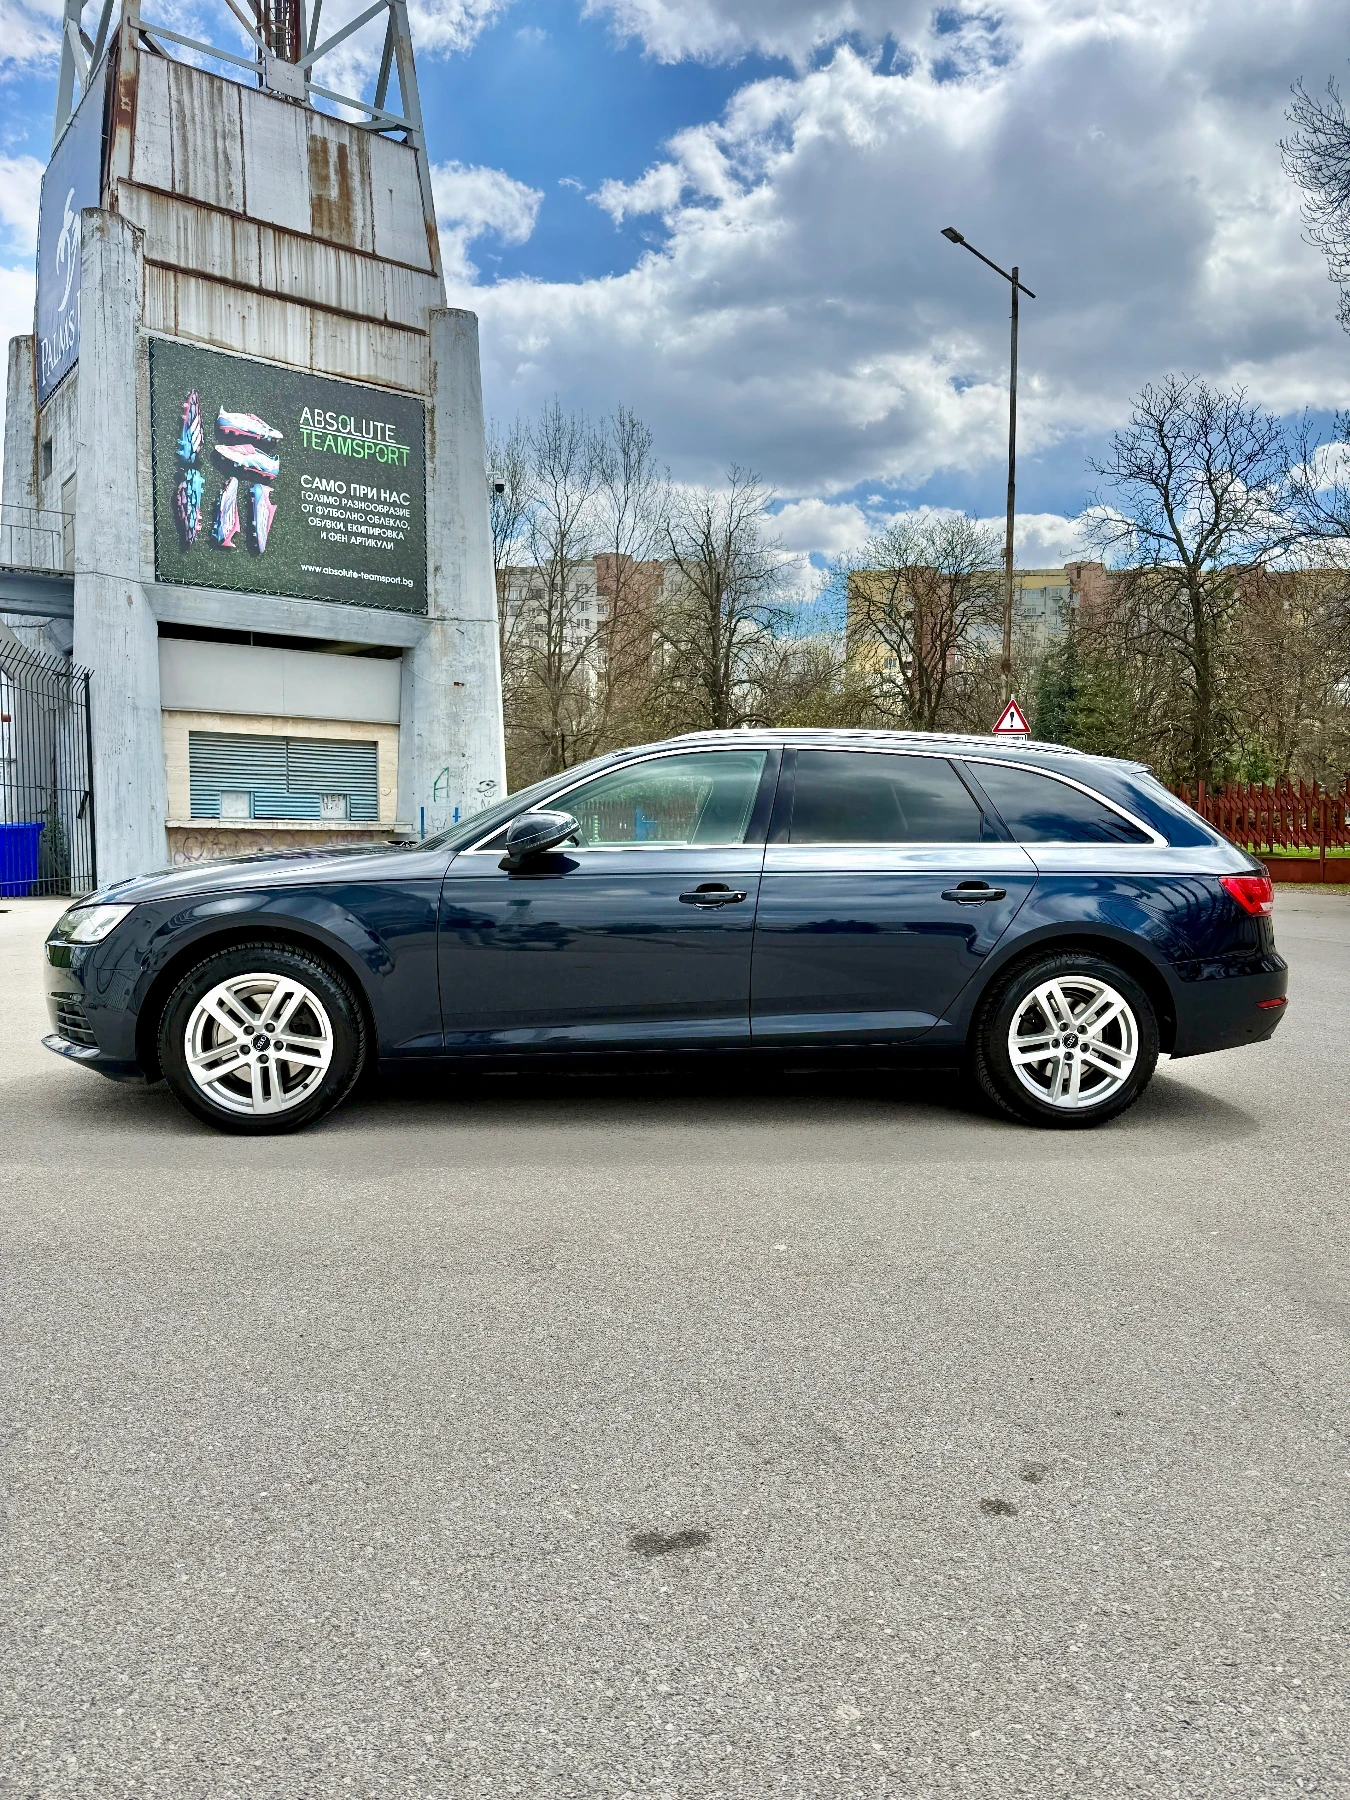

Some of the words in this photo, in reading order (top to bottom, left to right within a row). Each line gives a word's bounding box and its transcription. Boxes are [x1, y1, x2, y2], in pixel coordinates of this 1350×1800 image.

[41, 309, 75, 387] PALMS
[300, 406, 396, 443] ABSOLUTE
[300, 428, 410, 467] TEAMSPORT
[300, 474, 347, 495] САМО
[351, 483, 377, 500] ПРИ
[381, 488, 411, 506] НАС
[301, 490, 340, 506] ГОЛЯМО
[342, 498, 411, 518] РАЗНООБРАЗИЕ
[301, 503, 313, 513] ОТ
[315, 505, 365, 522] ФУТБОЛНО
[367, 514, 411, 531] ОБЛЕКЛО,
[308, 516, 346, 532] ОБУВКИ,
[348, 523, 404, 540] ЕКИПИРОВКА
[320, 531, 327, 540] И
[328, 532, 348, 543] ФЕН
[350, 535, 394, 551] АРТИКУЛИ
[301, 563, 414, 588] www.absolute-teamsport.bg
